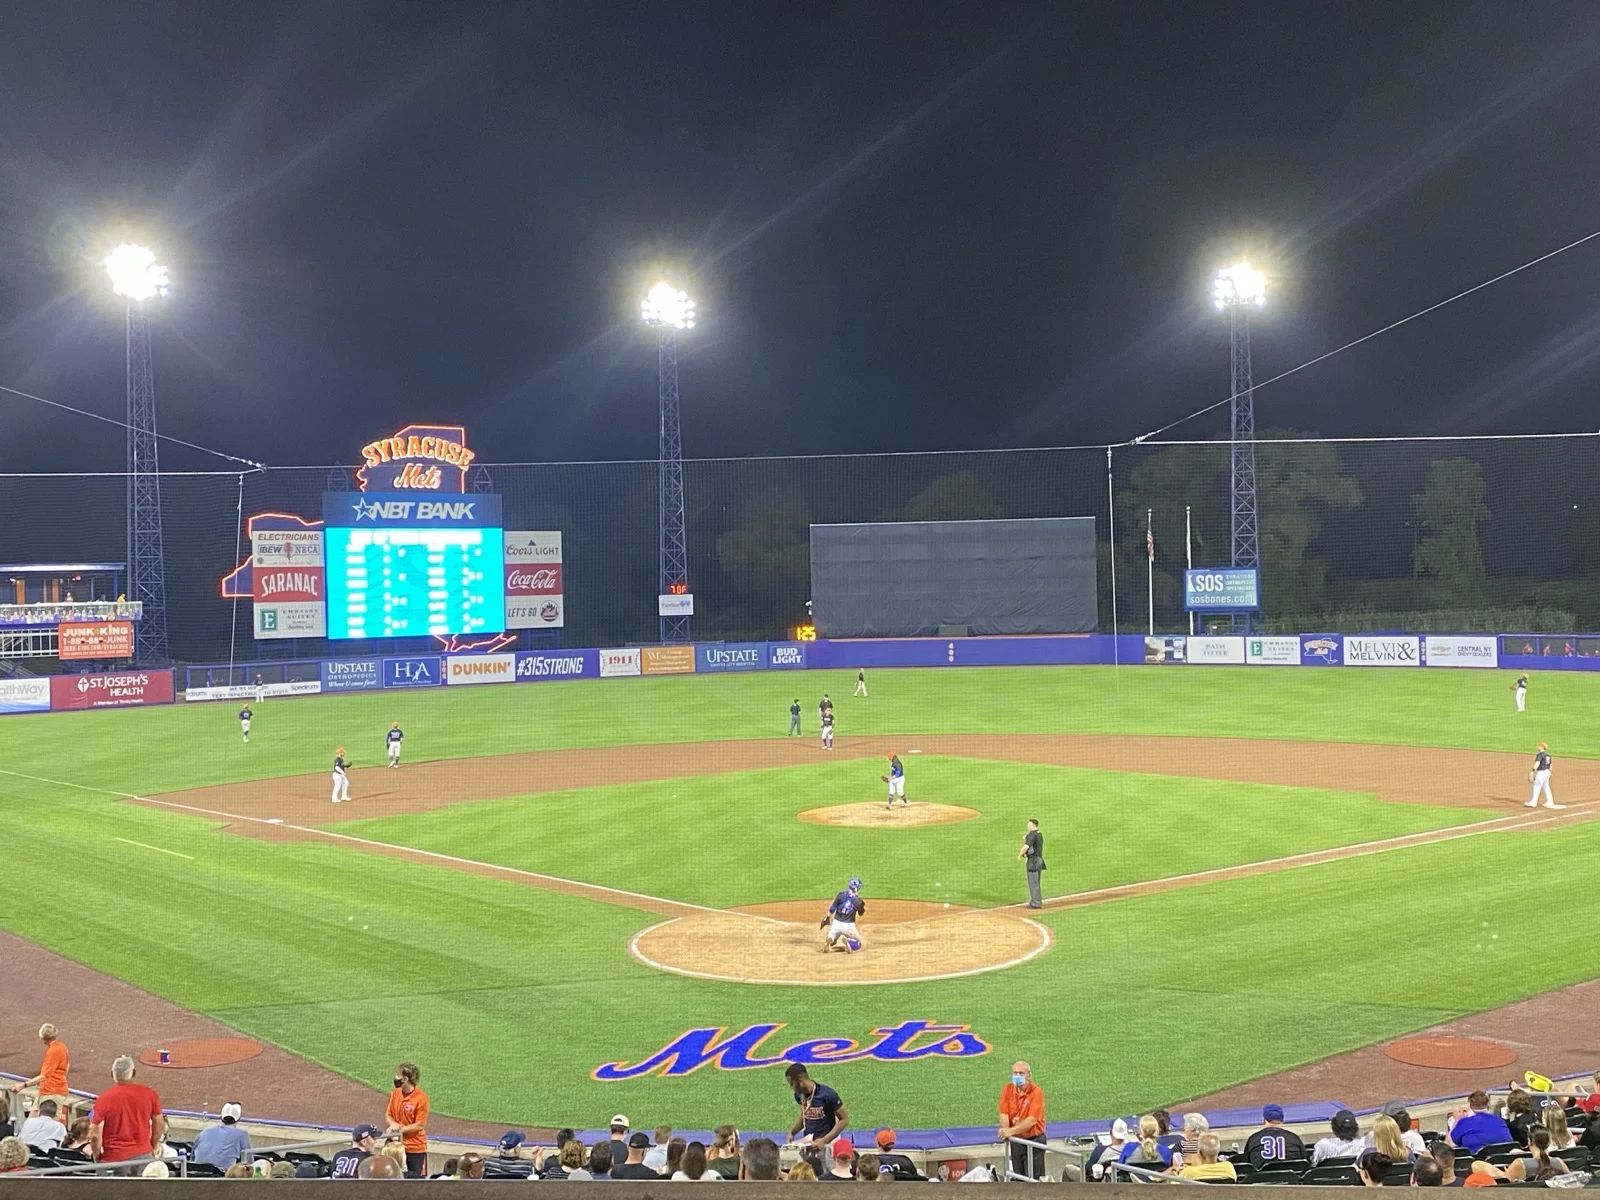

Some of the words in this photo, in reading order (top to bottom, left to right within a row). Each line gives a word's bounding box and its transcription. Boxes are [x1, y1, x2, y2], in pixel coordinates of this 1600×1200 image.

[361, 435, 475, 471] SYRACUSE
[393, 463, 442, 489] Mets
[370, 502, 415, 519] NBT
[416, 502, 476, 520] BANK
[258, 533, 319, 541] ELECTRICIANS
[260, 546, 282, 554] IBEW
[295, 546, 318, 554] NECA
[507, 544, 533, 556] Coors
[535, 547, 559, 556] LIGHT
[261, 572, 318, 597] SARANAC
[507, 569, 558, 590] Coca-Cola
[1196, 574, 1224, 592] SOS
[1190, 594, 1253, 604] sosbones.com
[508, 607, 526, 618] LET'S
[528, 607, 538, 617] GO
[63, 628, 94, 637] JUNK
[100, 624, 128, 636] KING
[706, 649, 758, 663] UPSTATE
[776, 647, 798, 656] BUD
[1350, 641, 1402, 653] MELVIN
[1397, 642, 1417, 661] &
[1350, 652, 1395, 660] MELVIN
[609, 656, 632, 665] 1911
[772, 655, 802, 664] LIGHT
[328, 662, 375, 674] UPSTATE
[452, 662, 511, 676] DUNKIN'
[517, 657, 584, 677] #315STRONG
[103, 674, 148, 689] JOSEPH'S
[110, 688, 143, 697] HEALTH
[591, 1020, 992, 1082] Mets
[1260, 1136, 1286, 1160] 31
[332, 1156, 359, 1180] 31
[951, 1170, 965, 1178] 109
